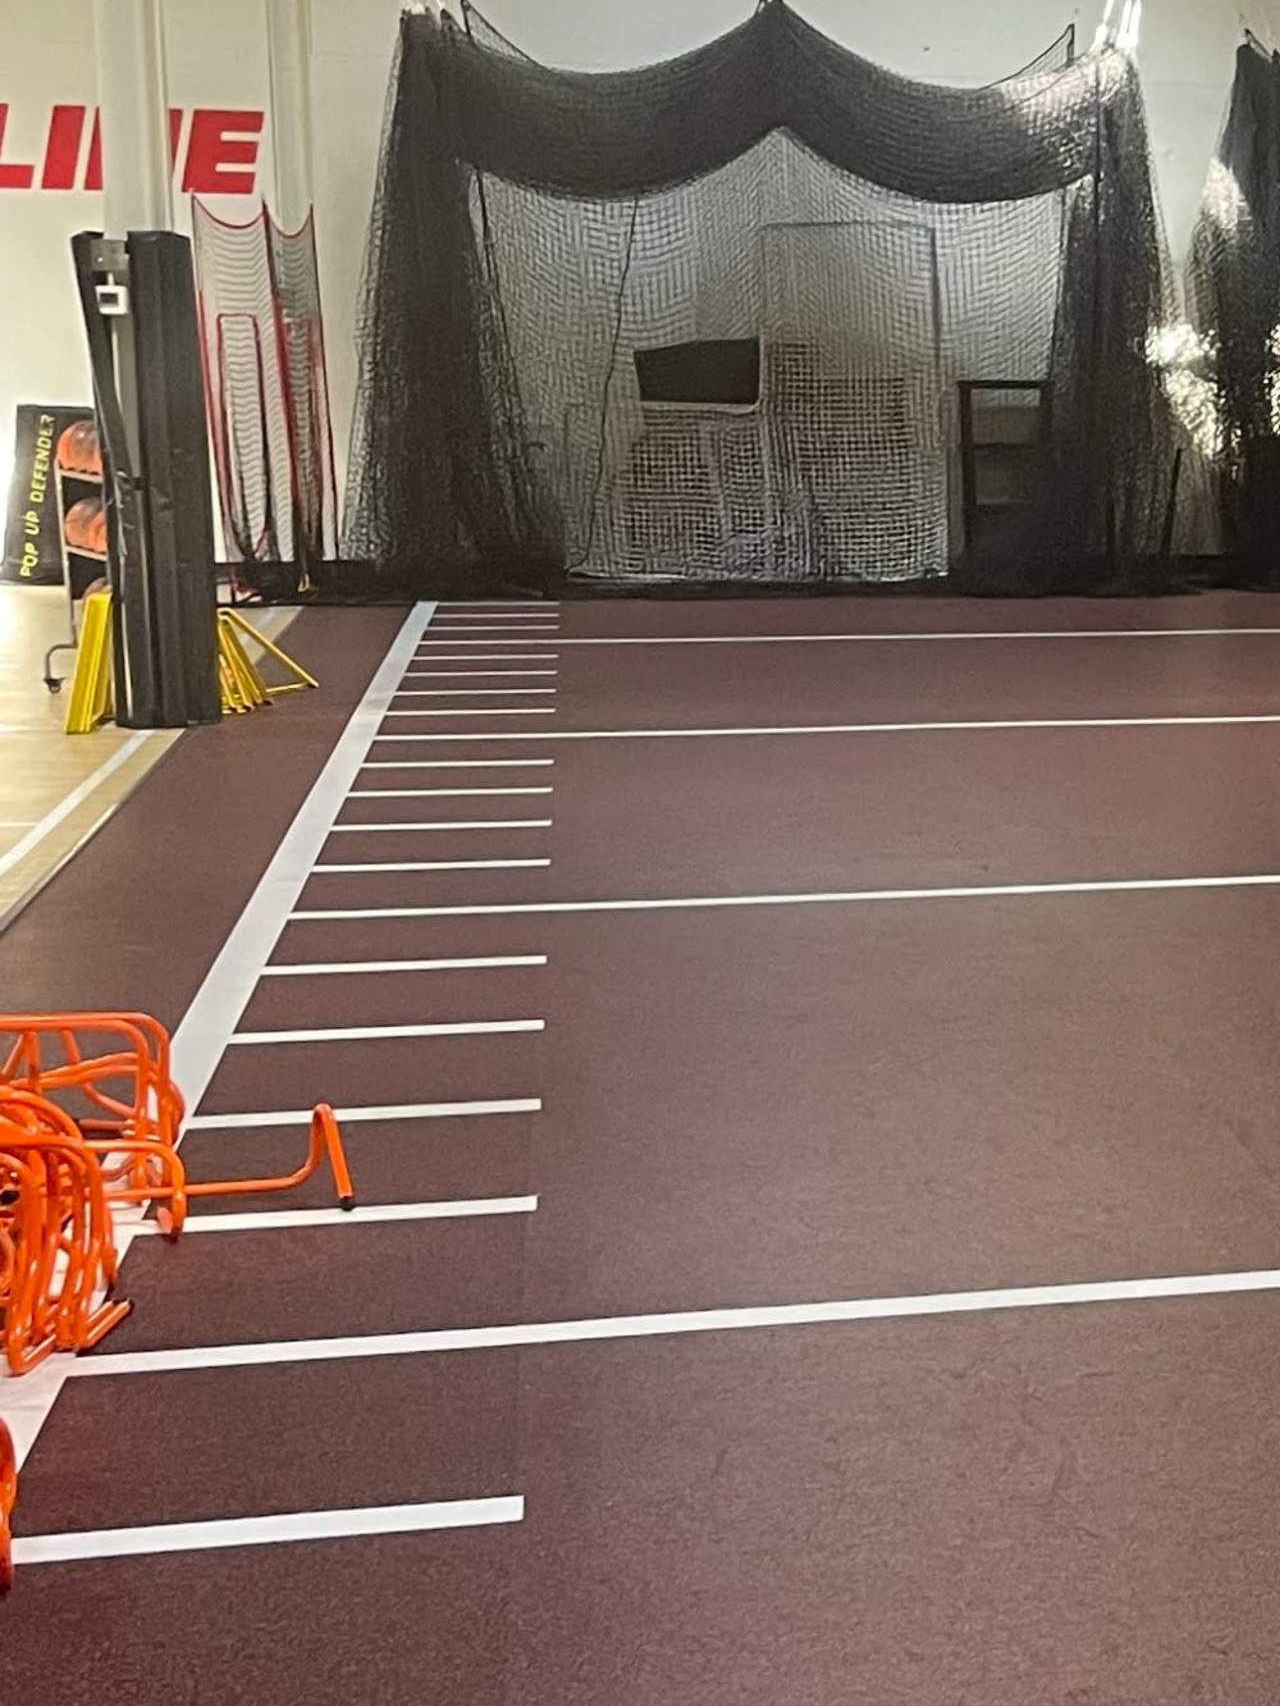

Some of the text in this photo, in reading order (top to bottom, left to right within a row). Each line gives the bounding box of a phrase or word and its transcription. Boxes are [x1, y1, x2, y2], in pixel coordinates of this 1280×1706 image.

[19, 414, 56, 577] POP UP DEFENDER
